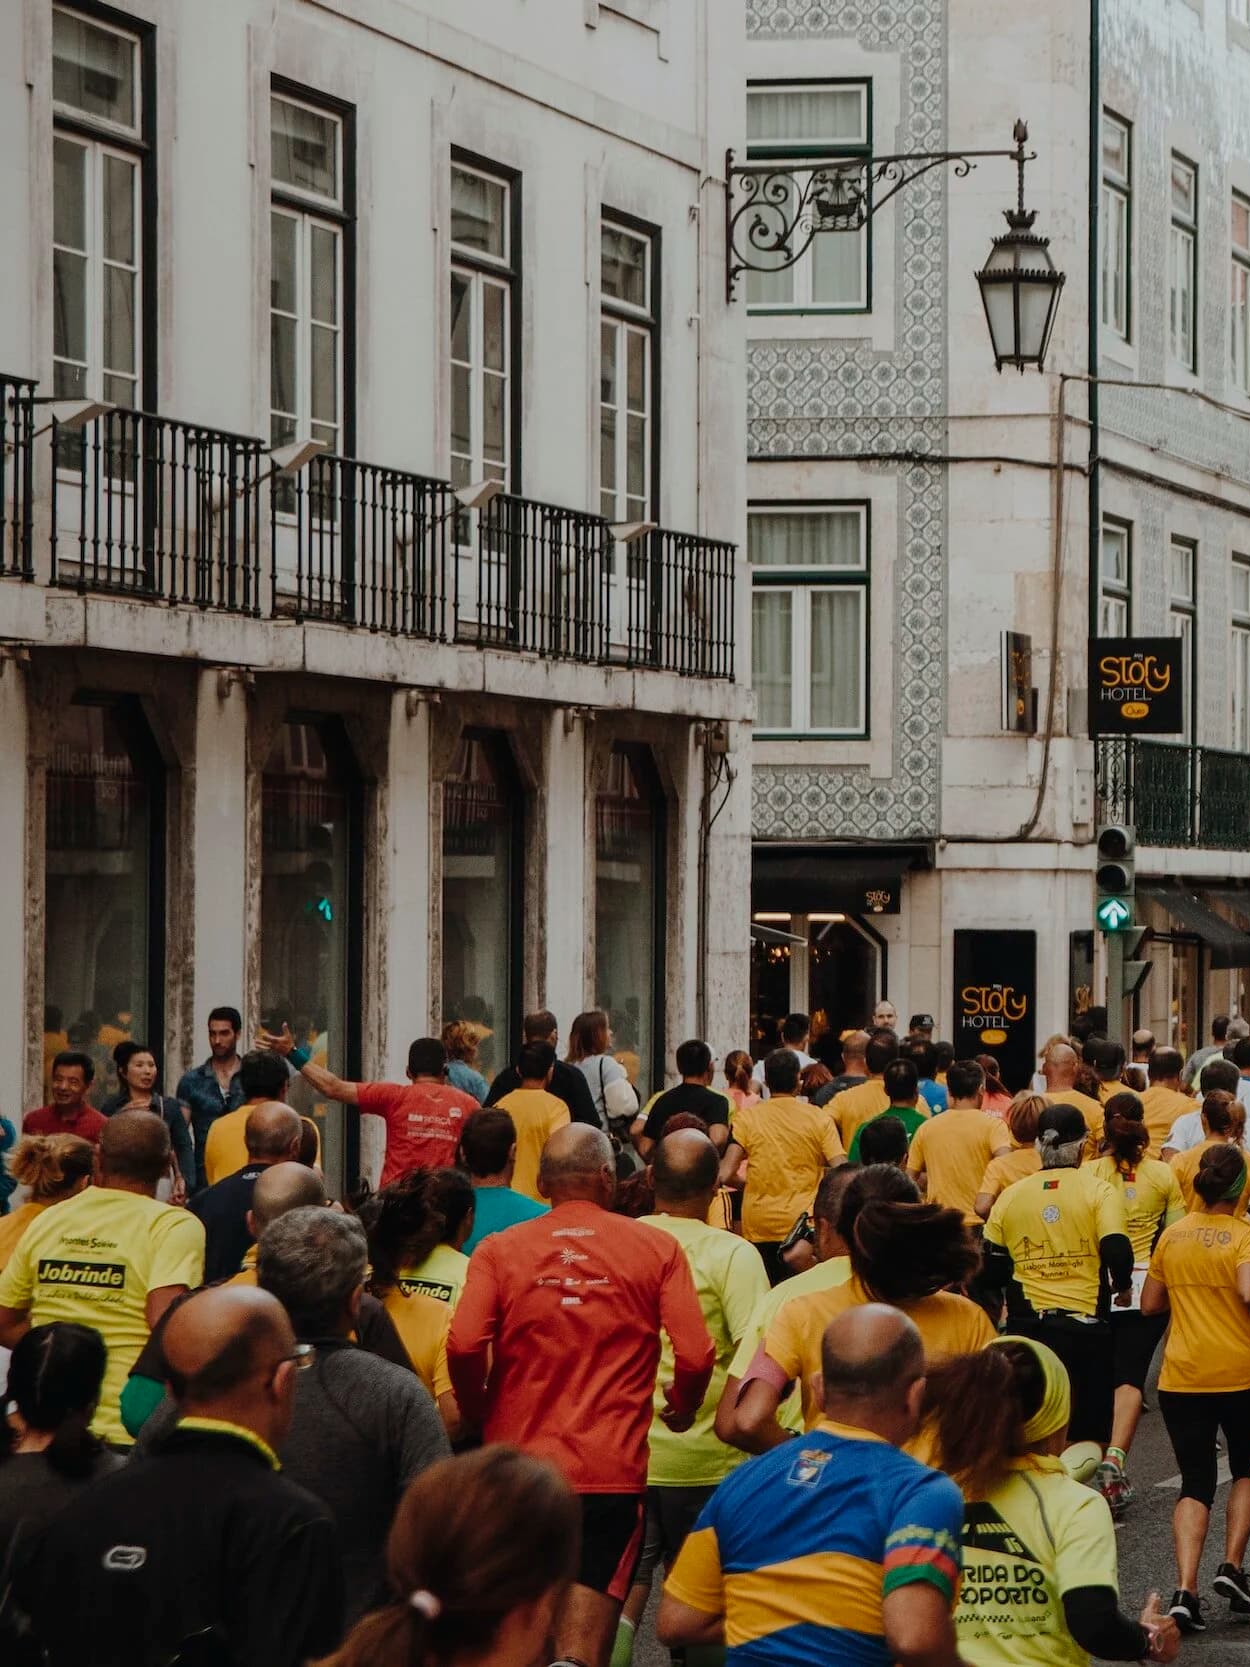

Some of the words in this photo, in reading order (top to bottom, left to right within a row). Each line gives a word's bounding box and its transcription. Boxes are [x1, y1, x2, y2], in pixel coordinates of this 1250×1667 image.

[1100, 656, 1170, 692] Story
[1101, 687, 1152, 701] HOTEL
[961, 986, 1026, 1020] Story
[962, 1015, 1010, 1029] HOTEL
[39, 1263, 123, 1286] Jobrinde
[400, 1281, 450, 1300] brinde
[962, 1564, 1009, 1583] RIDA
[1013, 1565, 1046, 1586] DO
[961, 1586, 1049, 1605] OPORTO
